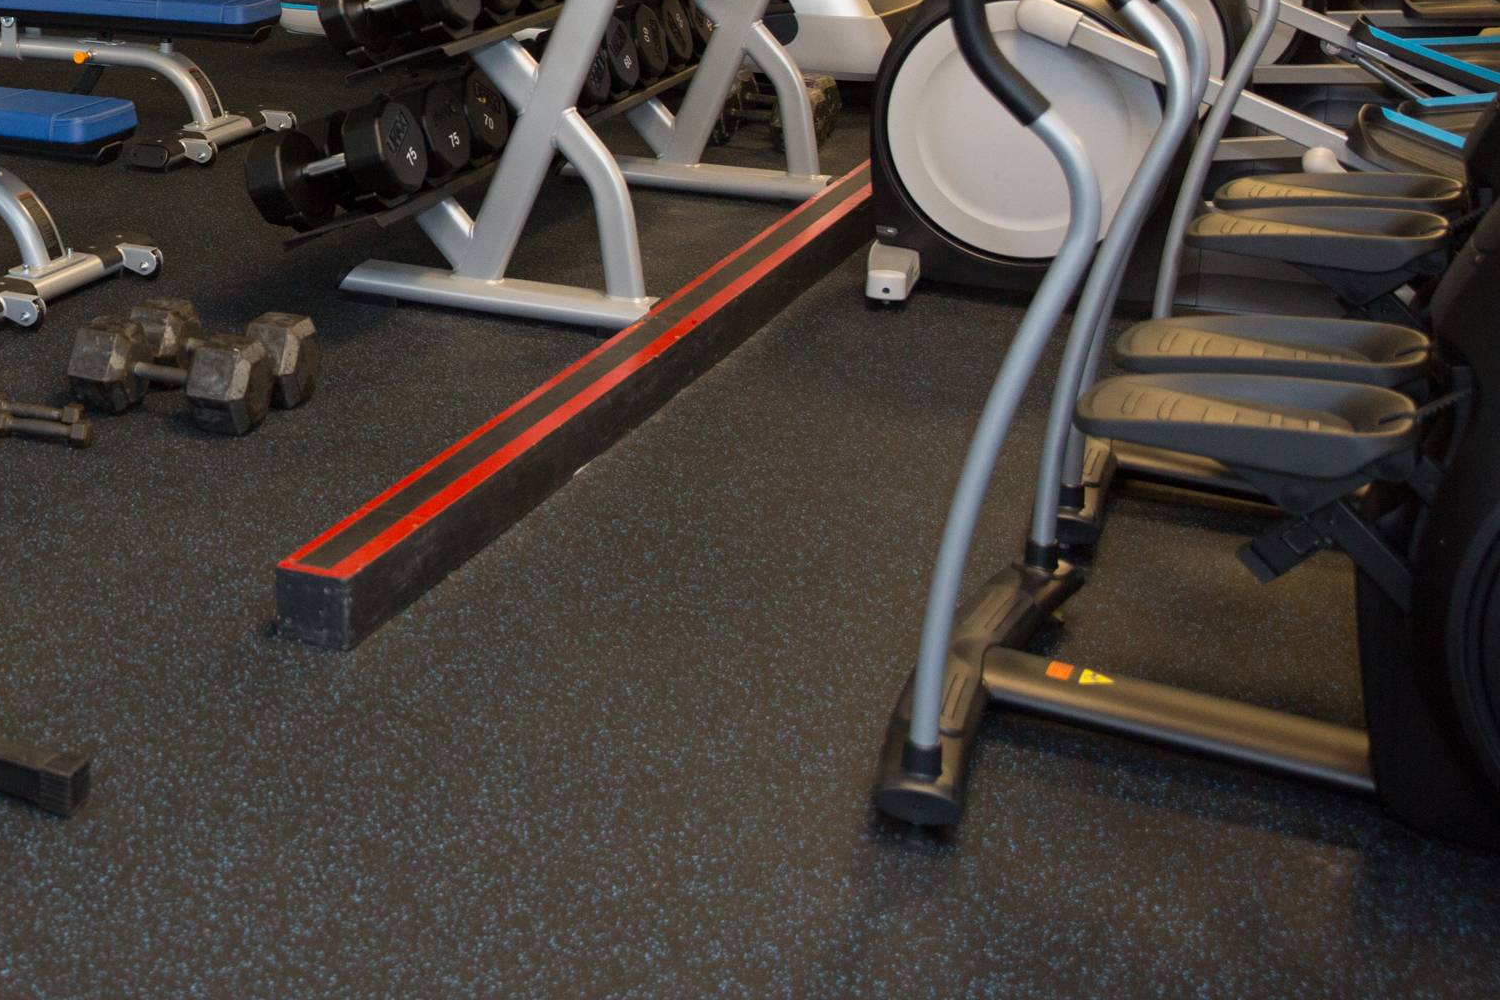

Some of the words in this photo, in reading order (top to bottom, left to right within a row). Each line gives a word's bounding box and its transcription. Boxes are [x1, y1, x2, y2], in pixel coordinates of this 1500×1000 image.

[483, 113, 495, 130] 70
[448, 131, 461, 148] 75
[405, 146, 418, 166] 75
